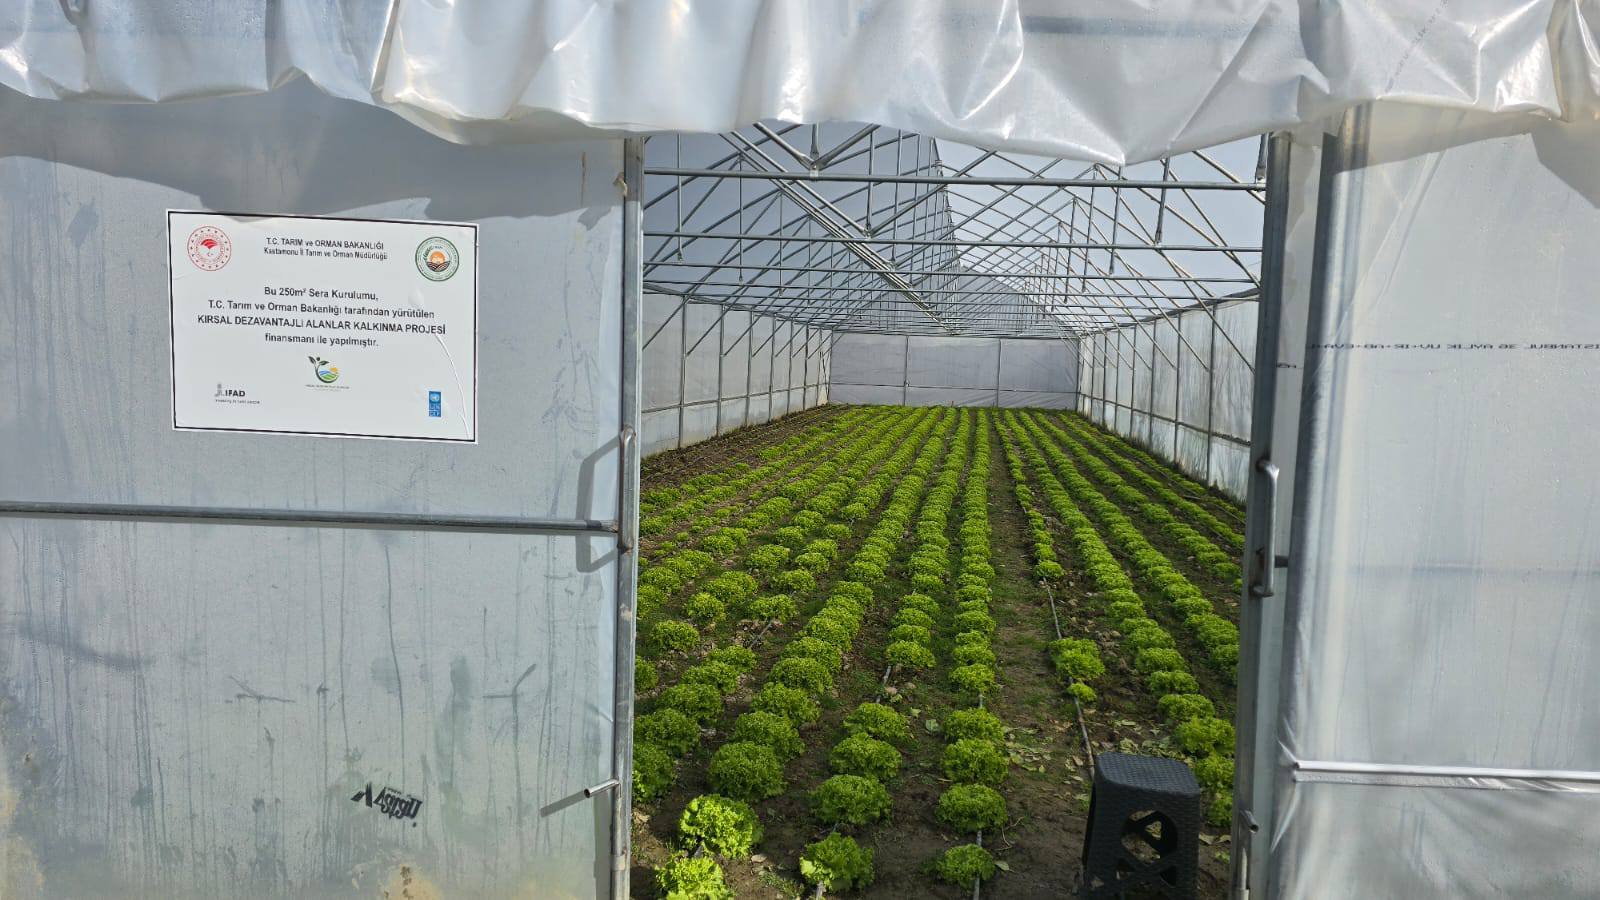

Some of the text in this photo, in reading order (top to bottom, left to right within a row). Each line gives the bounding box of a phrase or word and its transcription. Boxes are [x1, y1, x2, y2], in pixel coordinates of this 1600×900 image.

[266, 237, 280, 245] T.C.
[281, 237, 303, 246] TARIM
[315, 239, 342, 248] ORMAN
[343, 240, 384, 250] BAKANLIĞI
[264, 247, 298, 256] Kastamonu
[332, 250, 353, 258] Orman
[264, 286, 379, 301] Bu 250m² Sera Kurulumu,
[208, 299, 435, 319] T.C. Tarım ve Orman Bakanlığı tarafından yürütülen
[197, 314, 232, 325] KIRSAL
[305, 319, 351, 330] ALANLAR
[353, 321, 404, 333] KALKINMA
[405, 323, 446, 335] PROJESİ
[264, 332, 380, 348] finansmanı ile yapılmıştır.
[225, 389, 246, 397] IFAD
